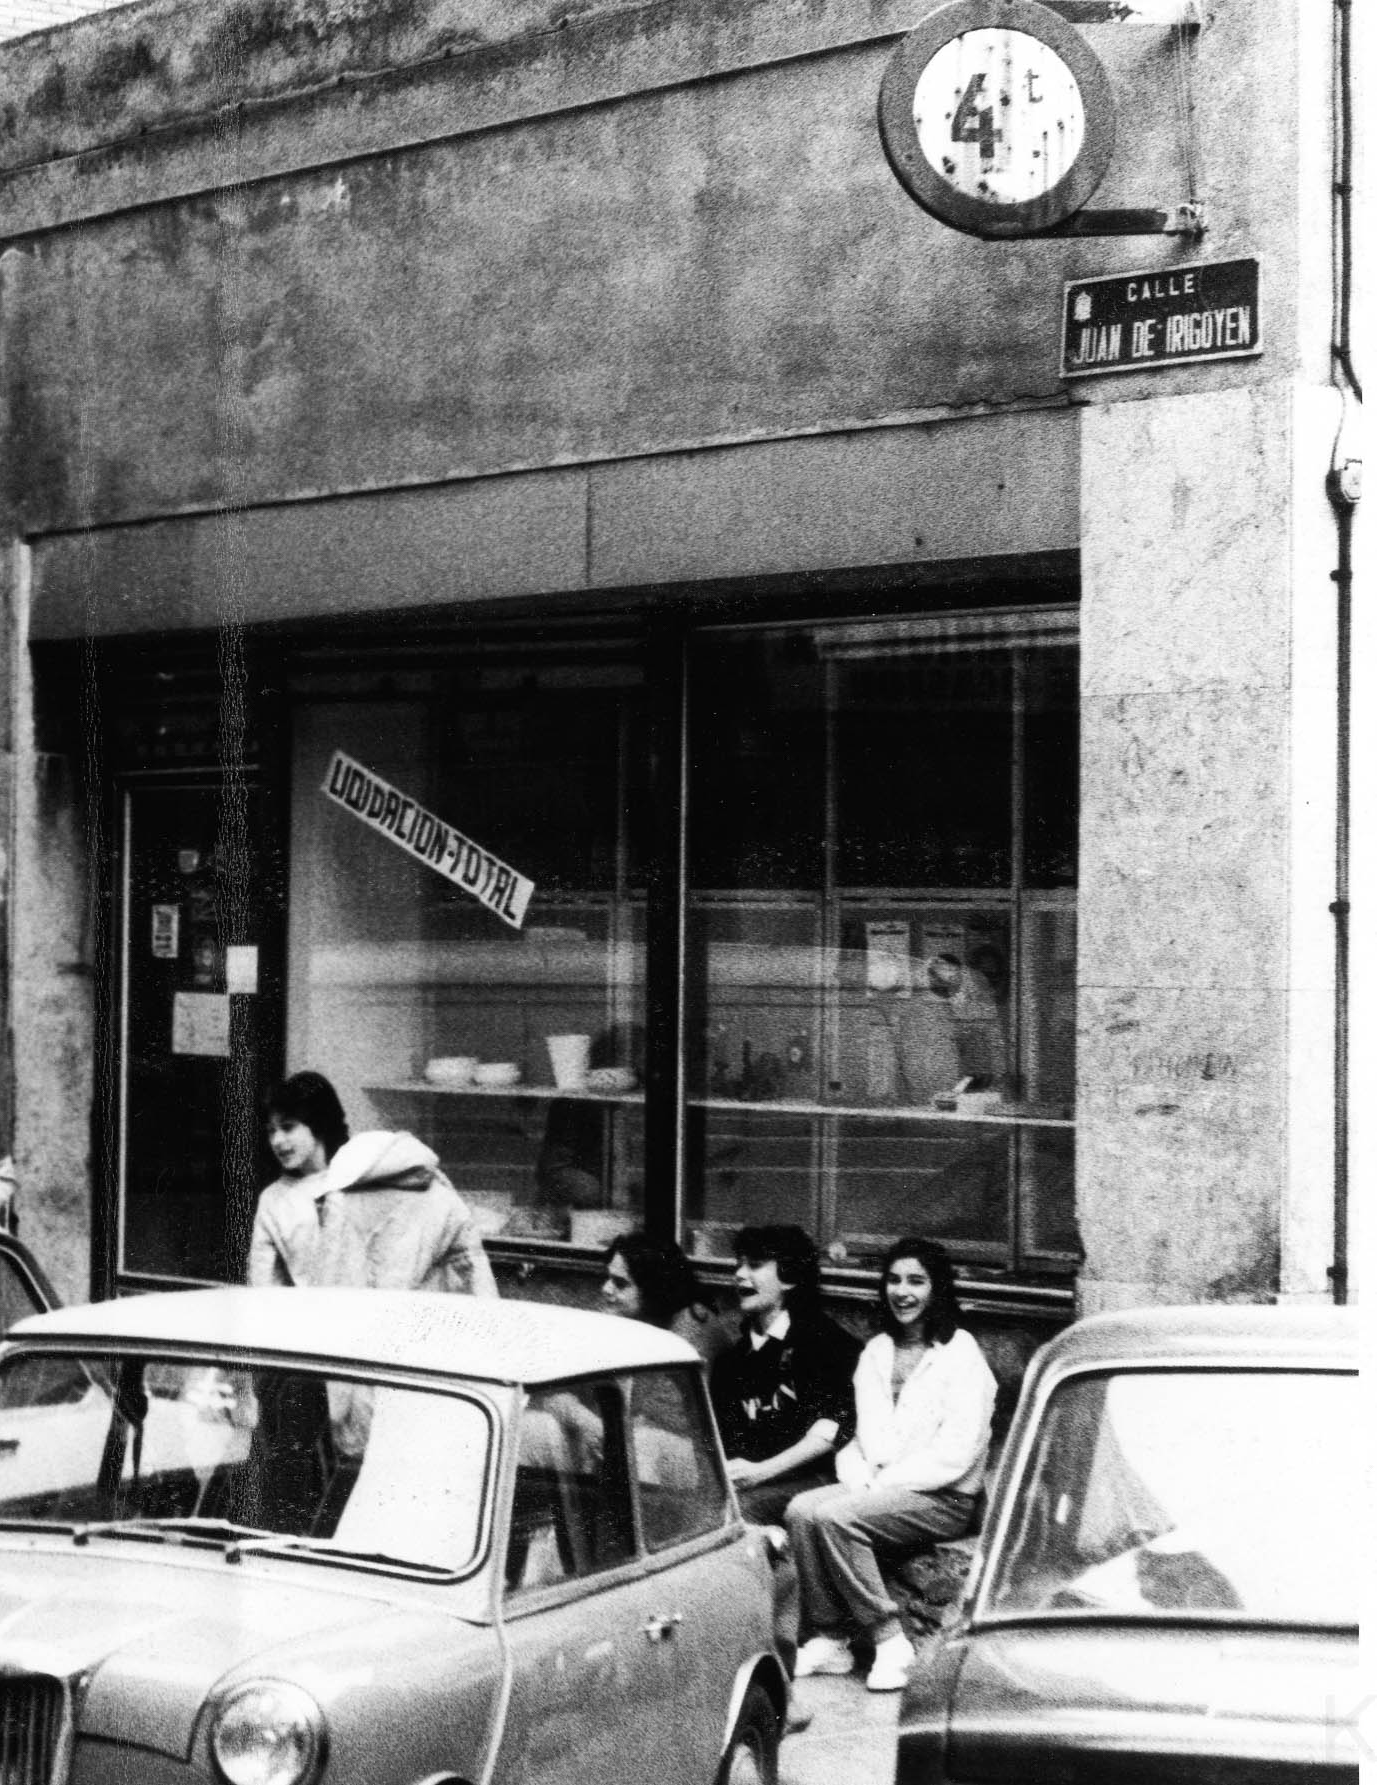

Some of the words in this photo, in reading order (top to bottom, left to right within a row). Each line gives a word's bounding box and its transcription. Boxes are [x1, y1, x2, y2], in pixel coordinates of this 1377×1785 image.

[951, 72, 1003, 159] 4
[1024, 68, 1043, 103] t
[1127, 273, 1195, 302] CALLE
[1073, 323, 1122, 365] JUAN
[1131, 319, 1157, 358] DE
[1166, 305, 1251, 353] IRIGOYEN
